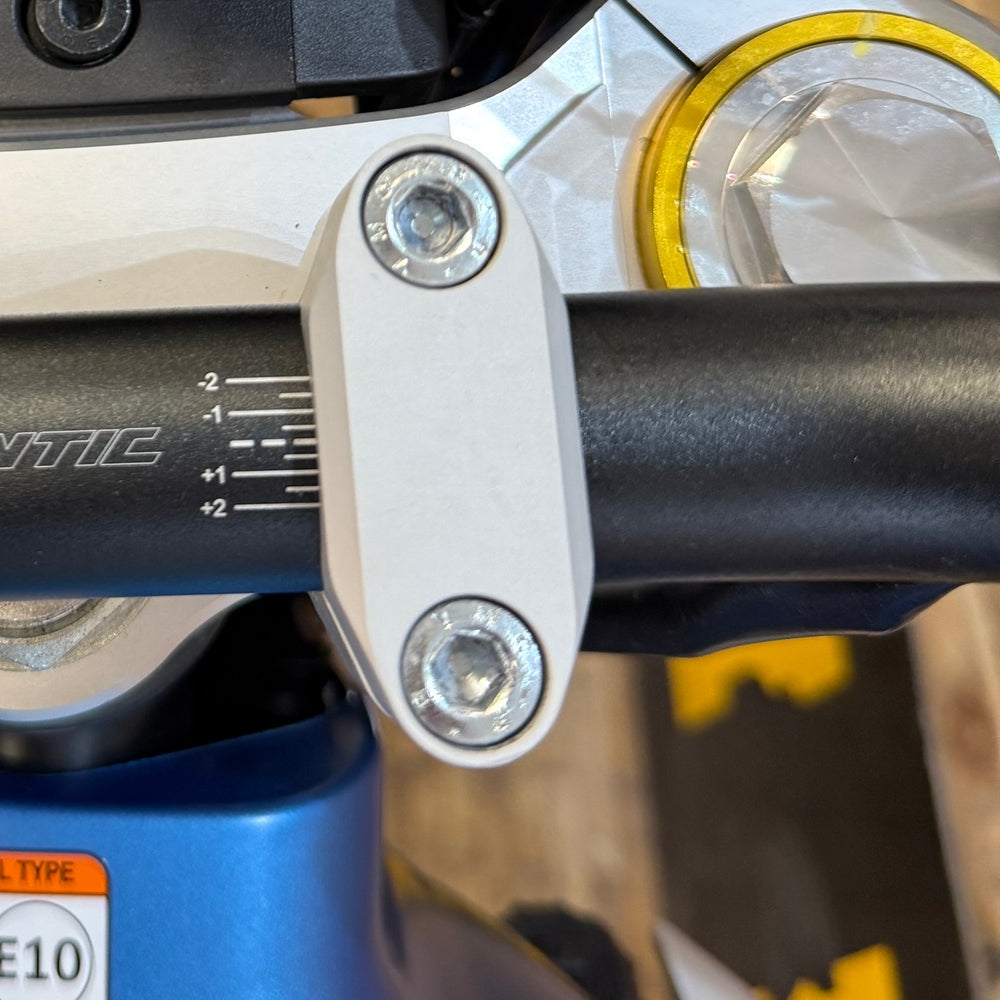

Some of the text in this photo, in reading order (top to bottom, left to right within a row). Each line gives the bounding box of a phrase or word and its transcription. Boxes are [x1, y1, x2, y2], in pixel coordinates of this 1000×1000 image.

[197, 371, 220, 392] -2
[202, 404, 223, 424] -1
[200, 464, 227, 485] +1
[200, 498, 228, 518] +2
[17, 859, 75, 883] TYPE
